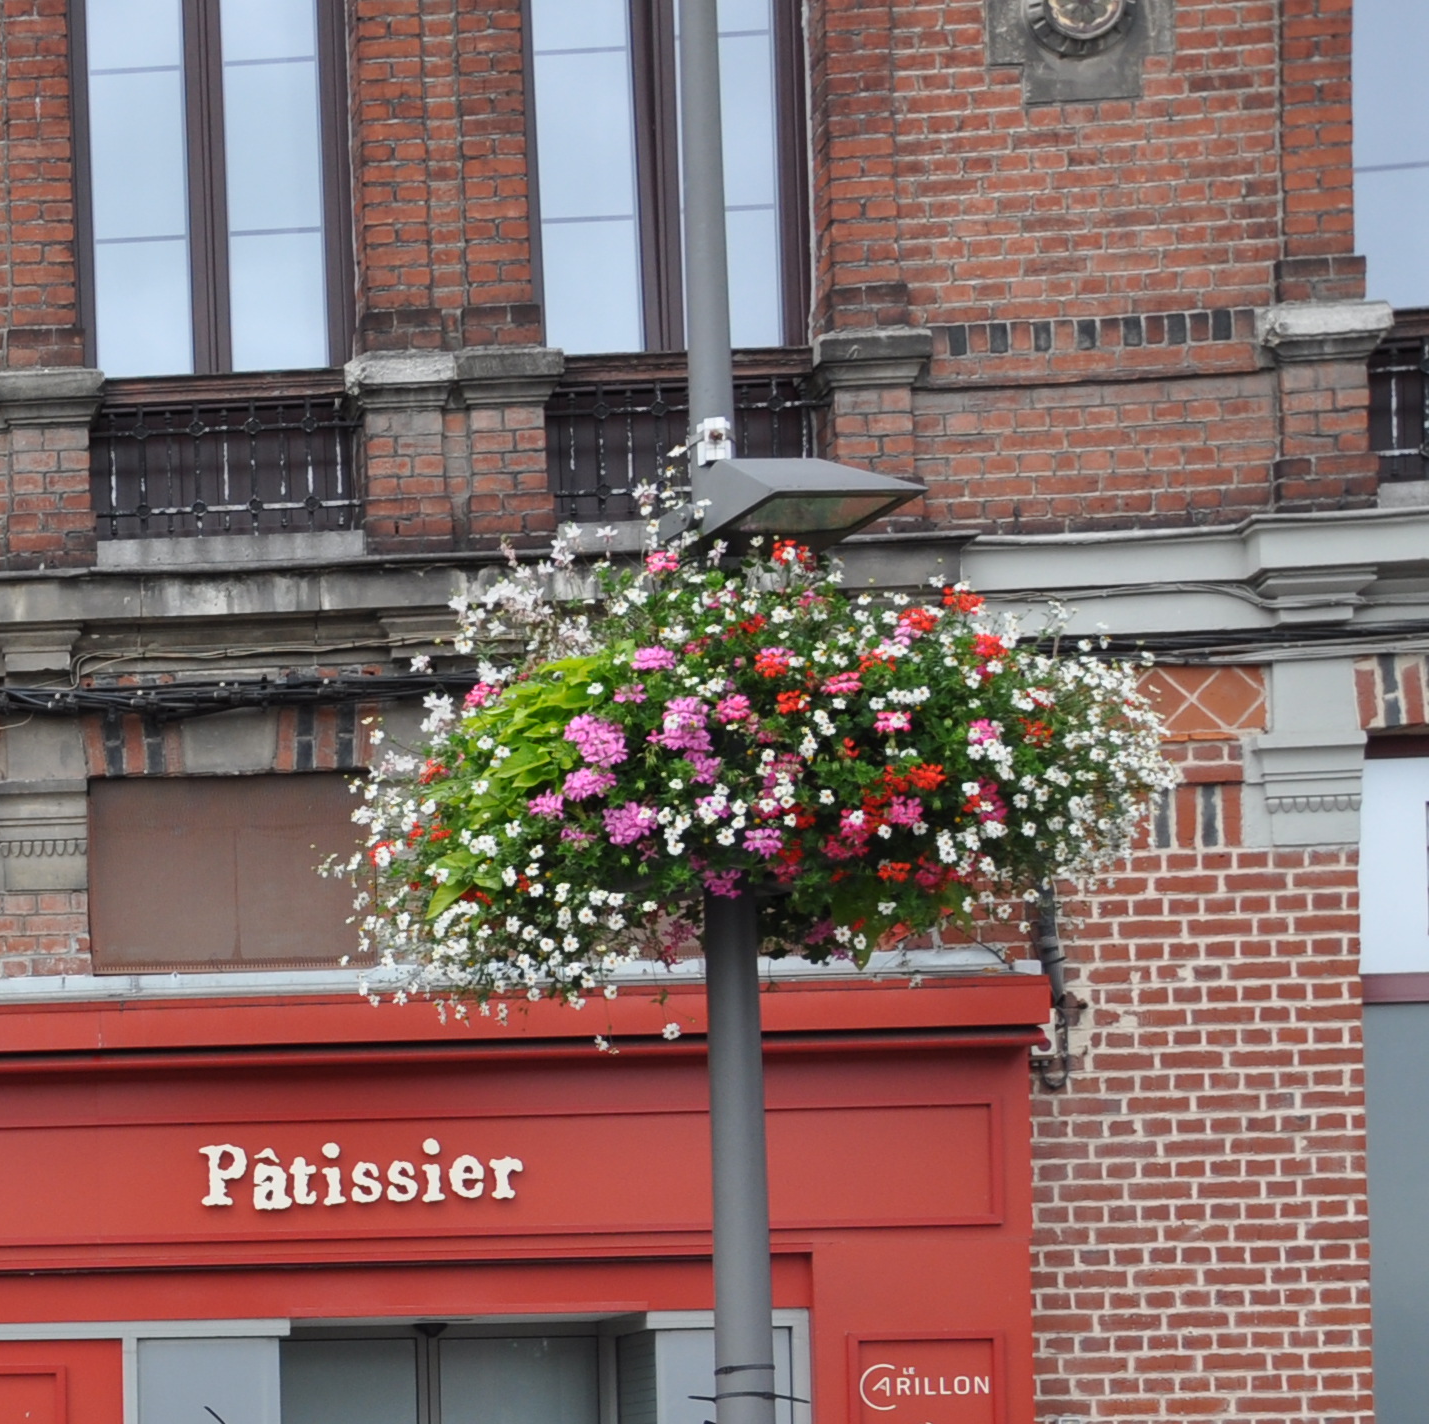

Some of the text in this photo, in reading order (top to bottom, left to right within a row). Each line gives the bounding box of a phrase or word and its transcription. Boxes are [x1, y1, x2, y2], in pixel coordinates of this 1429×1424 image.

[199, 1138, 524, 1211] Pâtissier
[859, 1363, 990, 1411] CARILLON
[902, 1366, 915, 1375] LE
